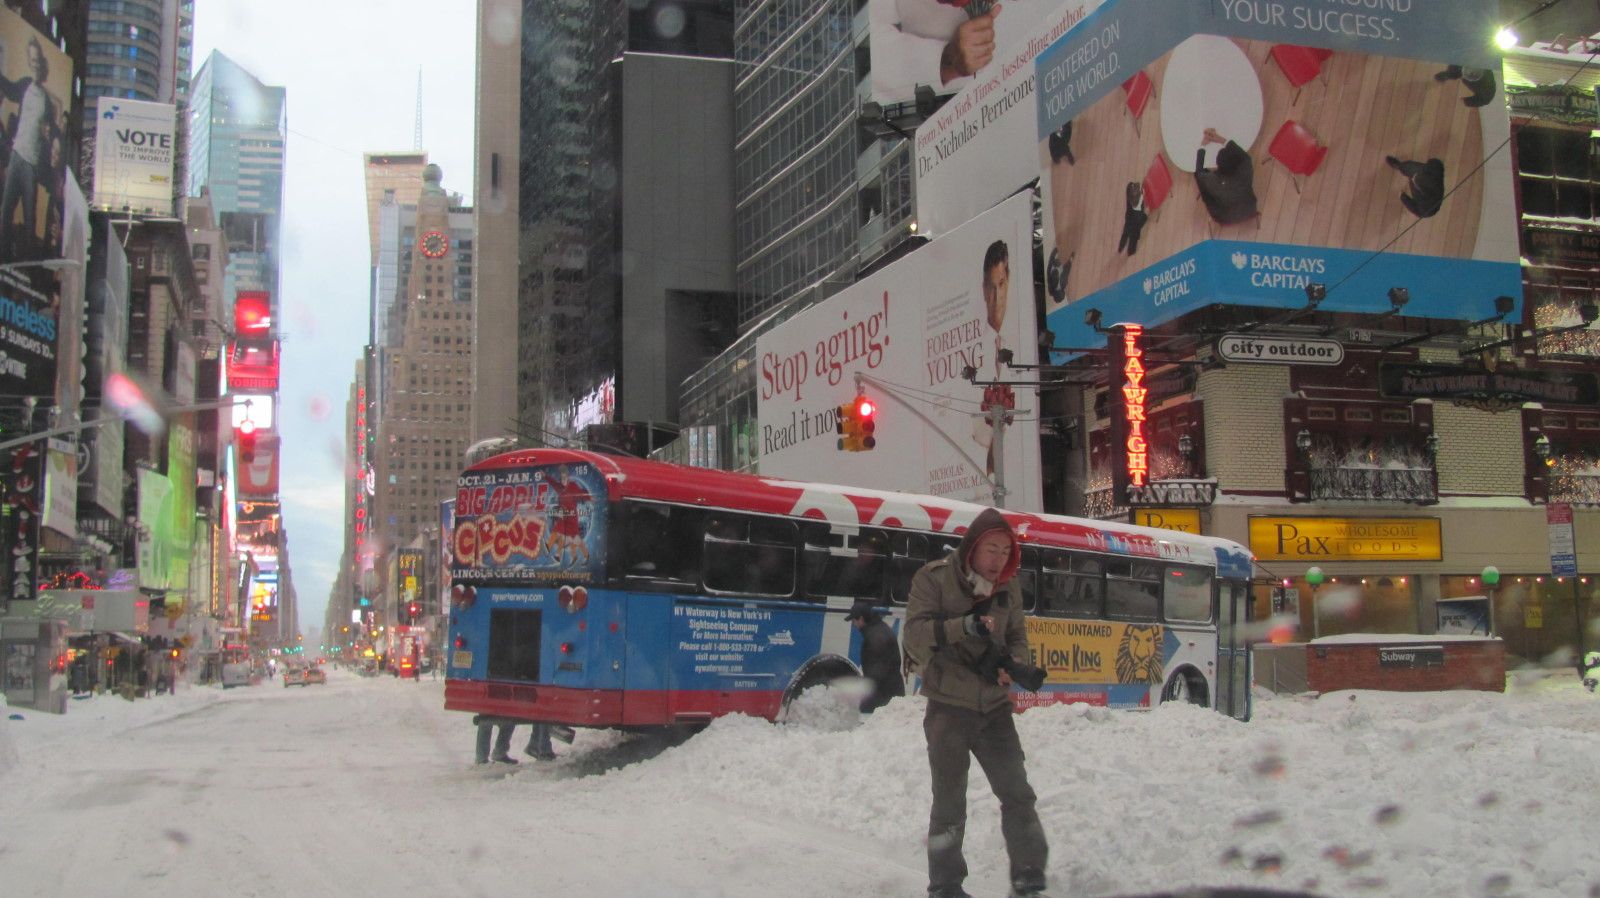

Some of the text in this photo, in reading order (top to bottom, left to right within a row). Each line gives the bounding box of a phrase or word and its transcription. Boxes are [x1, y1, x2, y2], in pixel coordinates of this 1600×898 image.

[1221, 0, 1400, 41] YOUR SUCCESS.
[1001, 37, 1049, 81] bestselling
[1044, 19, 1121, 93] CENTERED ON
[1044, 52, 1121, 121] YOUR WORLD.
[918, 74, 1036, 178] Dr. Nicholas Perricone
[116, 128, 171, 149] VOTE
[120, 152, 171, 164] THE WORLD
[133, 146, 171, 156] IMPROVE
[1251, 254, 1326, 274] BARCLAYS
[1152, 258, 1196, 291] BARCLAYS
[1154, 282, 1190, 307] CAPITAL
[762, 349, 808, 402] Stop
[814, 290, 890, 387] aging!
[926, 318, 982, 358] FOREVER
[1231, 341, 1334, 358] city outdoor
[926, 342, 984, 386] YOUNG
[228, 377, 278, 389] TOSHIBA
[762, 411, 797, 456] Read
[800, 404, 816, 441] it
[505, 472, 532, 484] JAN.
[534, 471, 542, 481] 9
[455, 482, 550, 517] BIG APPLE
[1127, 483, 1212, 503] TAVERN
[1085, 532, 1105, 549] NY
[1274, 523, 1418, 556] Pax WHOLESOME
[1335, 539, 1419, 553] FOODS
[452, 568, 536, 580] LINCOLN CENTER
[674, 606, 771, 621] NY Waterway is New York's #1
[688, 619, 759, 634] Sightseeing Company
[692, 631, 702, 640] For
[703, 631, 719, 641] More
[1067, 624, 1112, 637] UNTAMED
[679, 641, 700, 651] Please
[700, 642, 713, 651] call
[695, 652, 708, 661] visit
[1041, 643, 1070, 668] LION
[1072, 643, 1102, 673] KING
[1381, 652, 1416, 663] Subway
[734, 680, 758, 689] BATTERY
